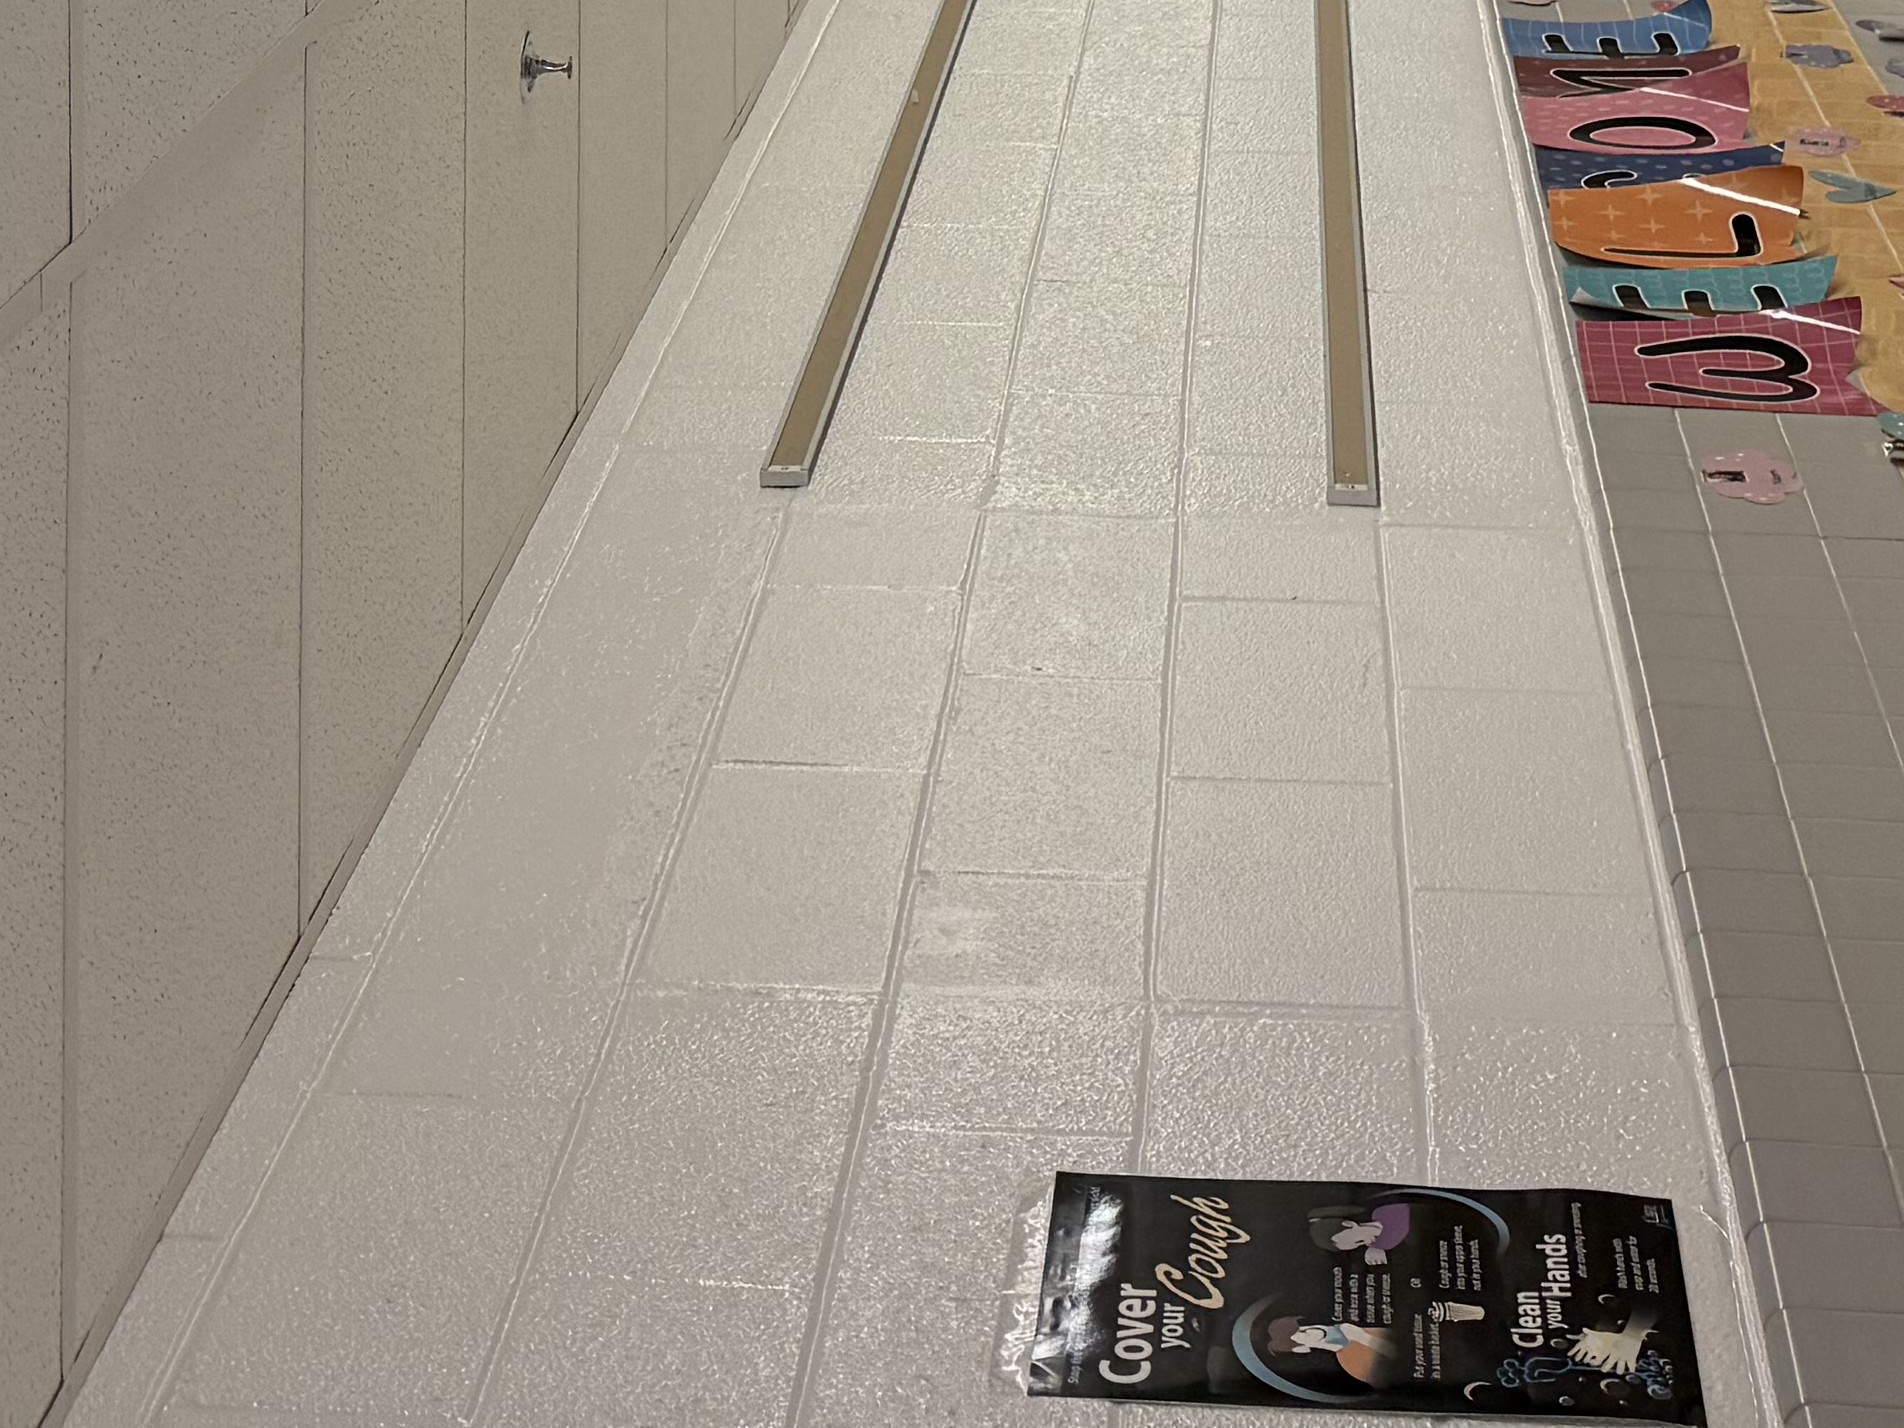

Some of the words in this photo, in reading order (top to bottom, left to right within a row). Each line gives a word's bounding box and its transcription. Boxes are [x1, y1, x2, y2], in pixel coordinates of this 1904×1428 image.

[1154, 1194, 1251, 1309] Cough
[1536, 1234, 1572, 1297] Hands
[1098, 1283, 1157, 1384] Cover
[1160, 1303, 1191, 1348] your
[1510, 1292, 1544, 1348] Clean
[1546, 1299, 1568, 1328] your
